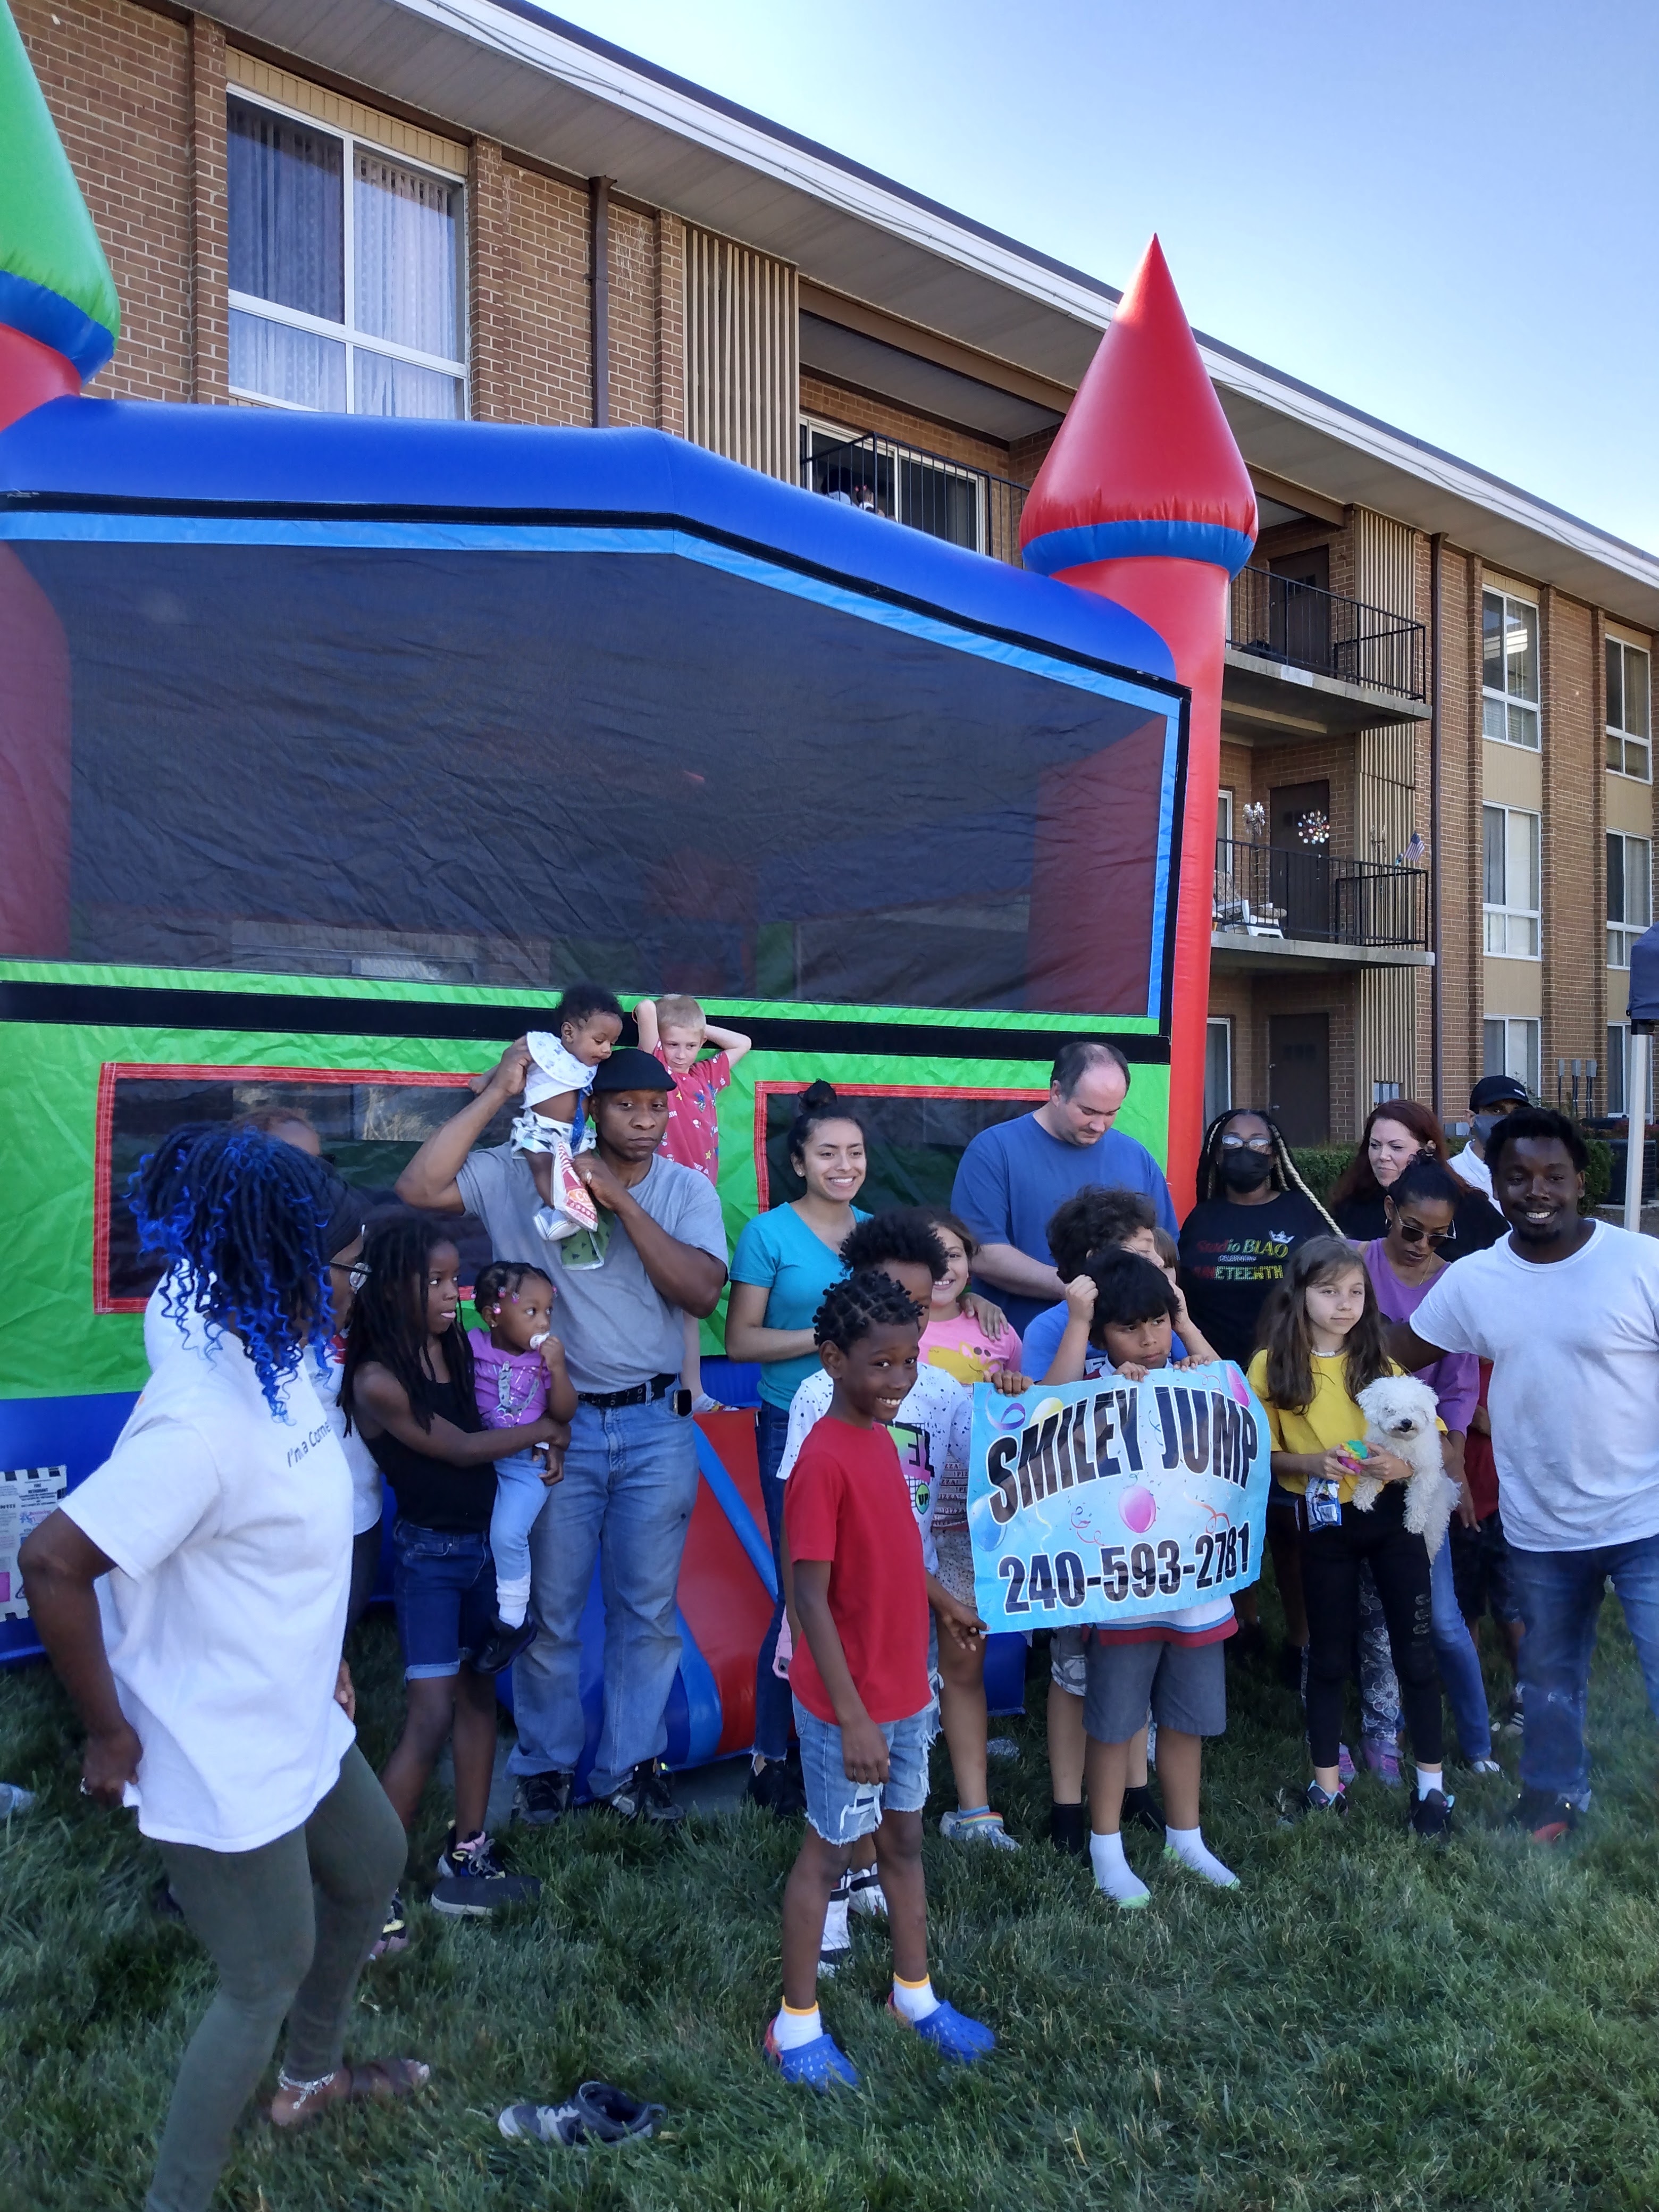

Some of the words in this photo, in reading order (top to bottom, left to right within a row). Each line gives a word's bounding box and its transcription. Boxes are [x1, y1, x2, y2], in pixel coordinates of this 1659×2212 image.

[287, 1447, 304, 1468] I'm
[301, 1441, 308, 1454] a
[986, 1386, 1144, 1526] SMILEY
[1153, 1386, 1258, 1490] JUMP
[918, 1493, 929, 1506] UP
[998, 1522, 1251, 1614] 240-593-2781
